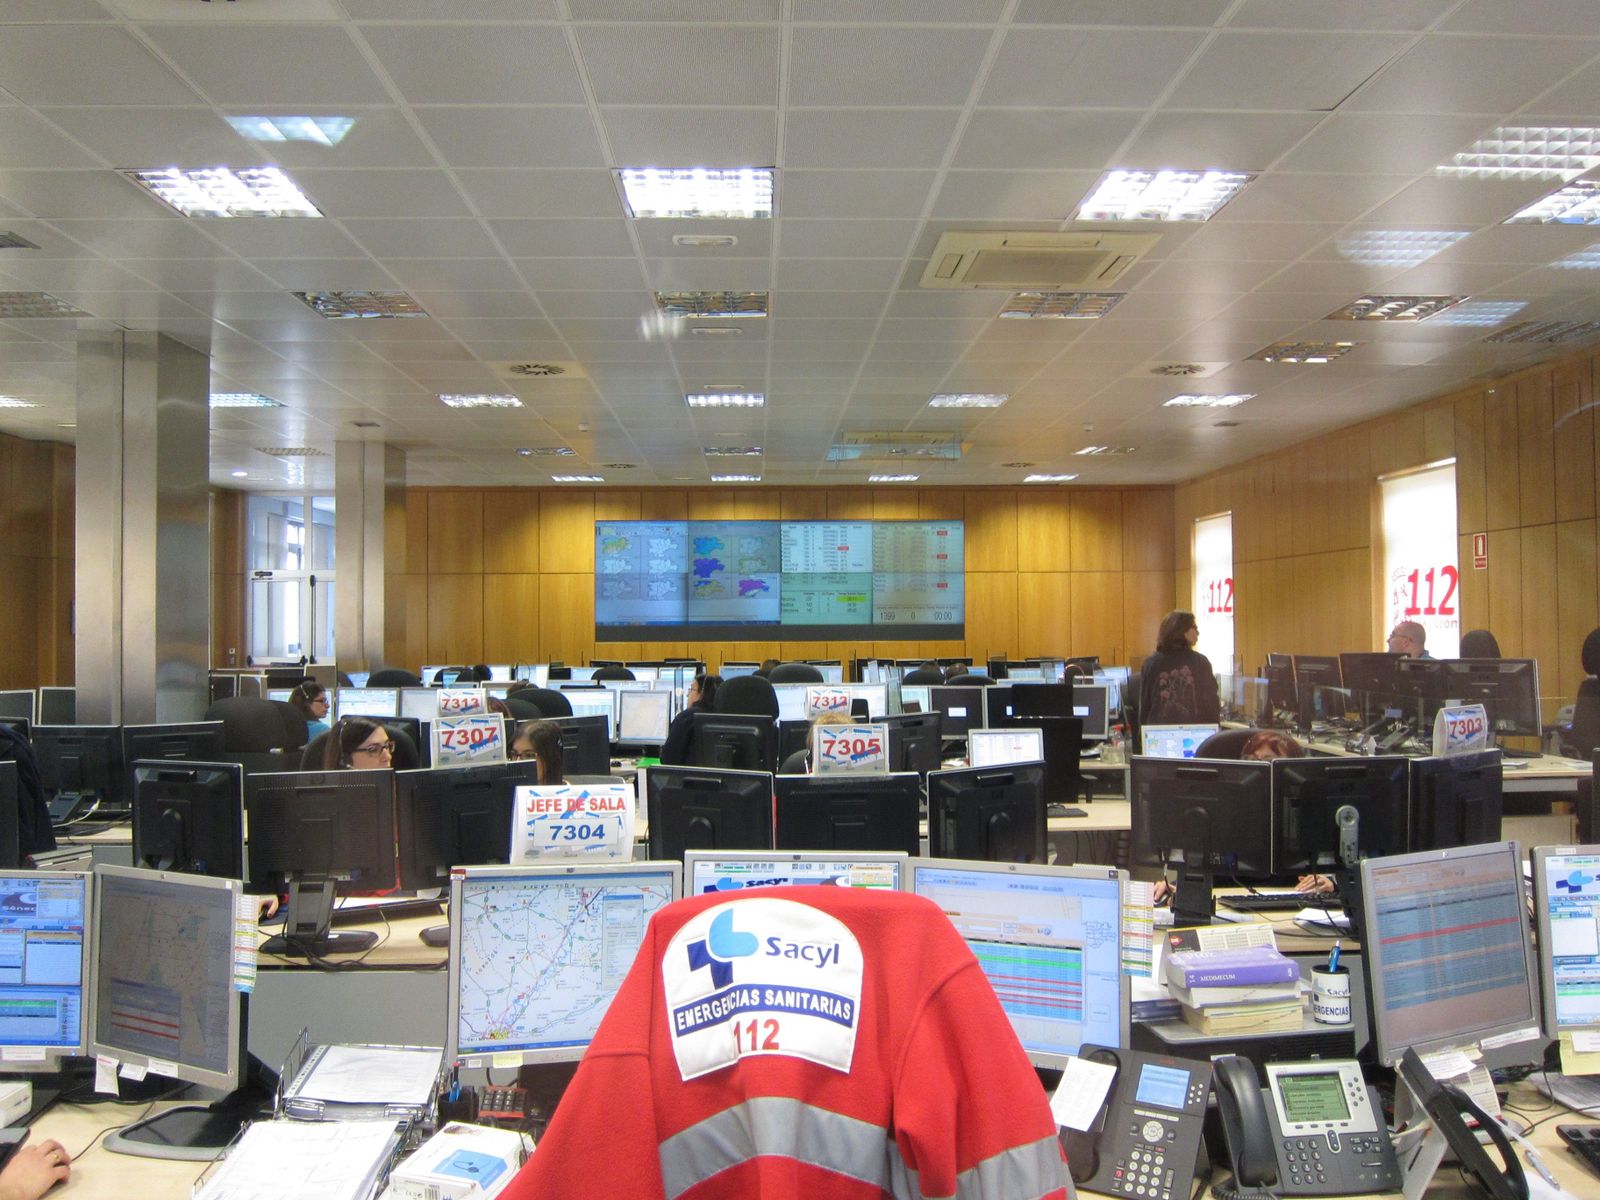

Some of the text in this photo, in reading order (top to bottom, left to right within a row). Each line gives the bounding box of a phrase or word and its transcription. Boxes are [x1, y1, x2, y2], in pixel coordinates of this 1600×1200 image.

[1208, 578, 1233, 612] 112
[1404, 565, 1458, 615] 112
[441, 698, 480, 710] 7313
[441, 726, 497, 747] 7307
[1449, 717, 1483, 737] 7303
[822, 738, 881, 756] 7305
[527, 797, 626, 813] JEFE DE SALA
[549, 824, 605, 841] 7304
[766, 936, 840, 969] Sacyl
[764, 989, 851, 1020] SANITARIAS
[733, 1018, 780, 1054] 112
